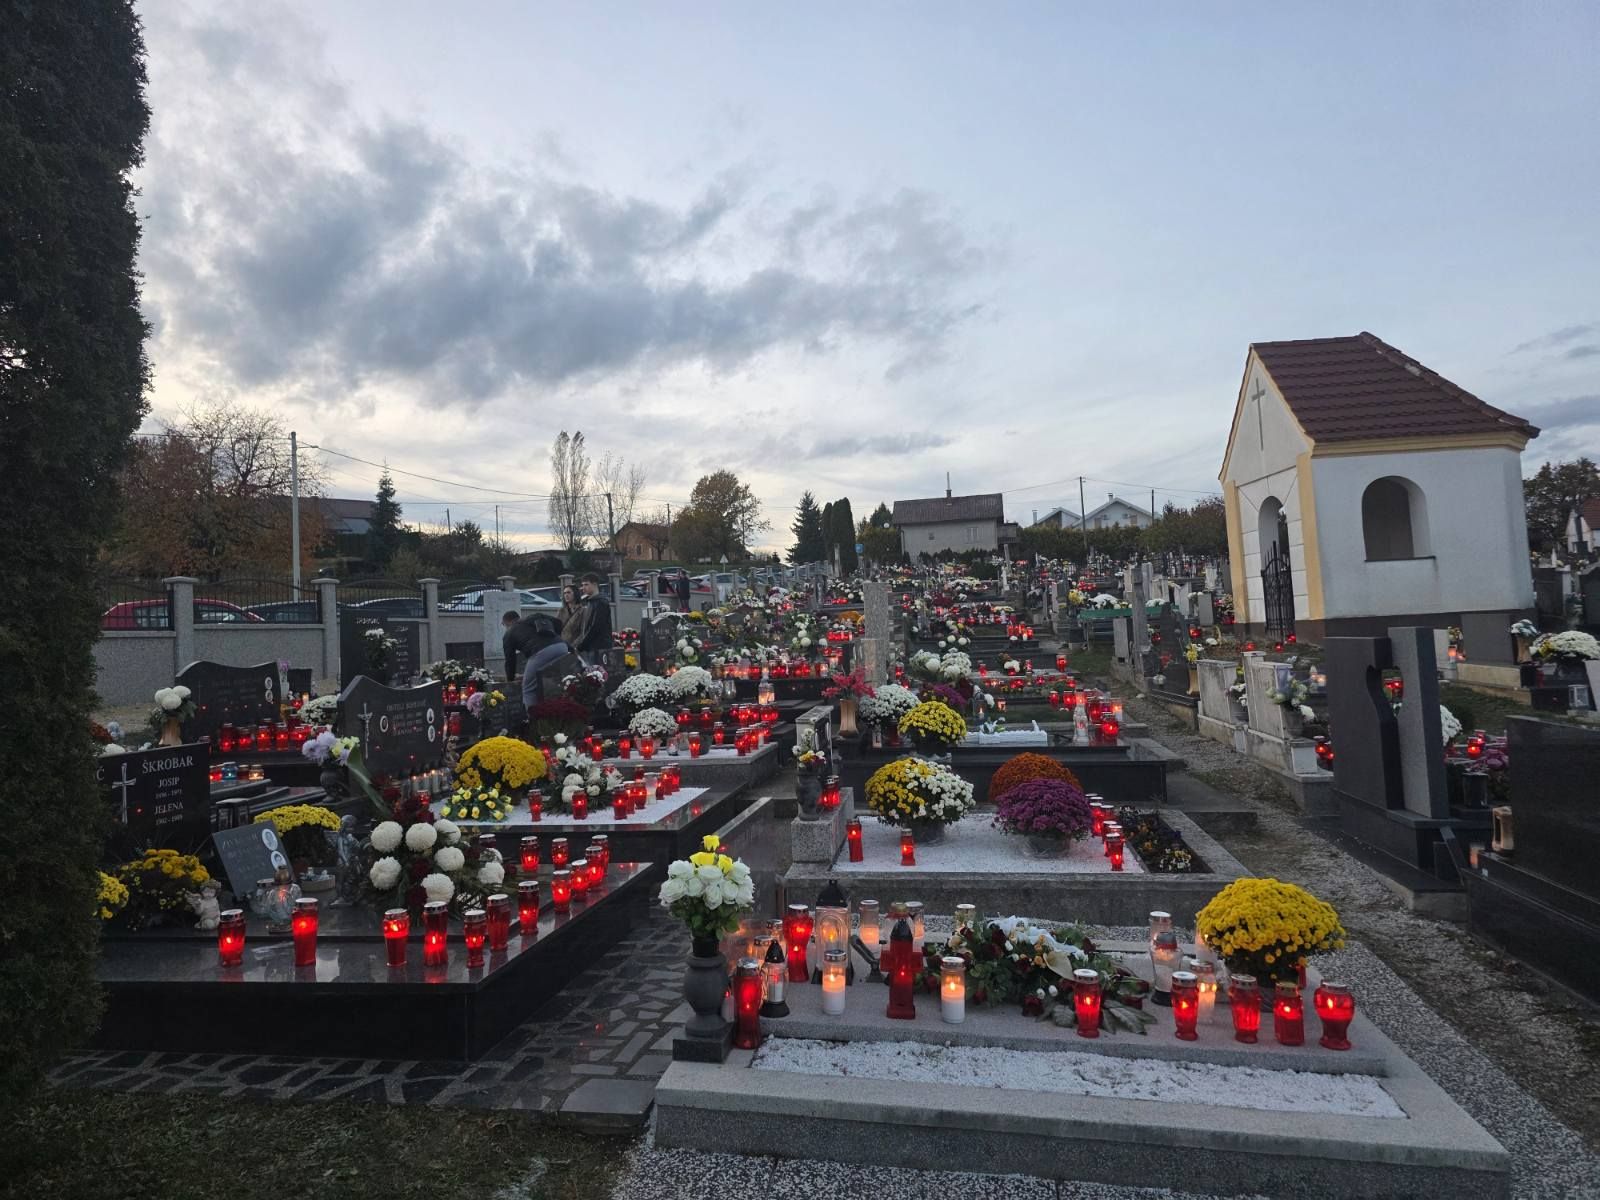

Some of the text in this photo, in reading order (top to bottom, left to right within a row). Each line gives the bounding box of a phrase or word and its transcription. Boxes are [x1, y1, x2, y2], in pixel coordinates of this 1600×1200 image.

[142, 756, 194, 774] ŠKROBAR
[158, 776, 180, 788] JOSIP
[154, 801, 184, 815] JELENA
